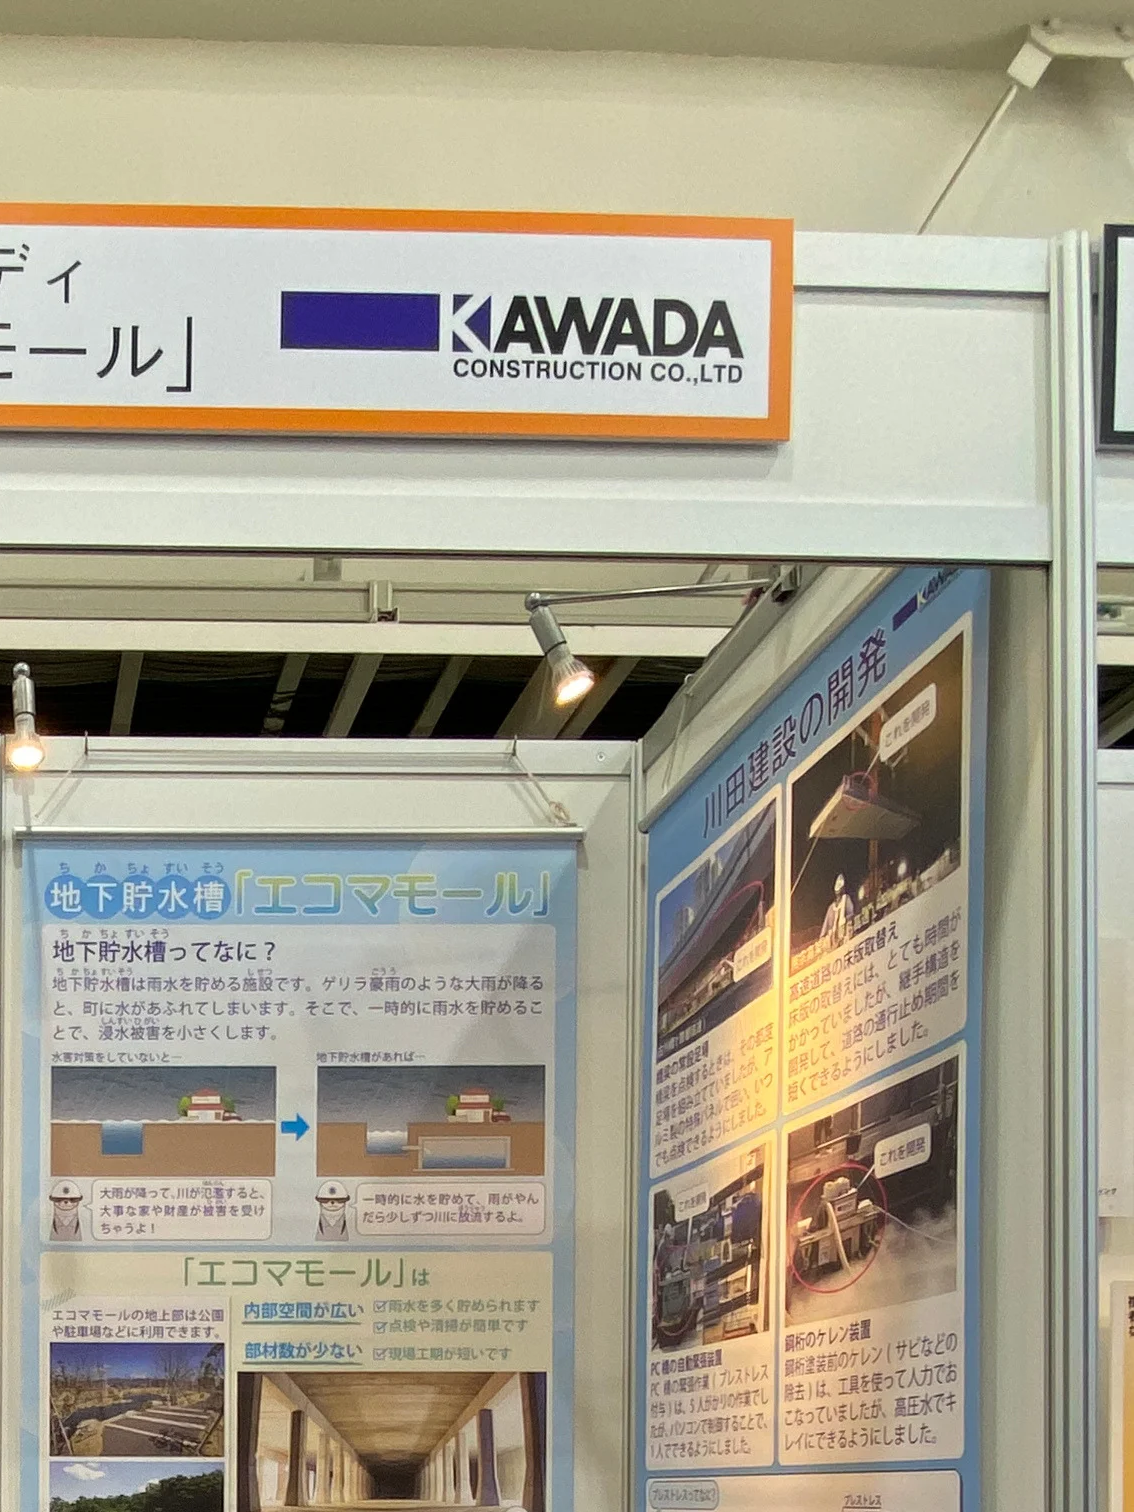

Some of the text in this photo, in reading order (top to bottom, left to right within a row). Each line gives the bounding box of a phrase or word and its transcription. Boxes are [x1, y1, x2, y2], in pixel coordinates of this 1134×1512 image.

[451, 293, 743, 358] KAWADA
[453, 360, 743, 386] CONSTRUCTION CO.,LTD
[703, 627, 887, 838] 川田建設の開発
[53, 941, 277, 963] 地下貯水槽ってなに？
[52, 1025, 278, 1041] とで、浸水被害を小さくします。
[362, 1193, 539, 1206] 一時的に水を貯めて、雨がやん
[100, 1205, 265, 1217] 大事な家や財産が被害を受け
[184, 1256, 430, 1290] 「エコマモール」は
[52, 1308, 224, 1323] エコマモールの地上部は公園
[244, 1302, 364, 1321] 内部空間が広い
[52, 1324, 222, 1340] や駐車場などに利用できます。
[244, 1341, 363, 1360] 部材数が少ない
[785, 1391, 956, 1427] こなっていましたが、高圧水でキ
[785, 1423, 936, 1452] レイにできるようにしました。
